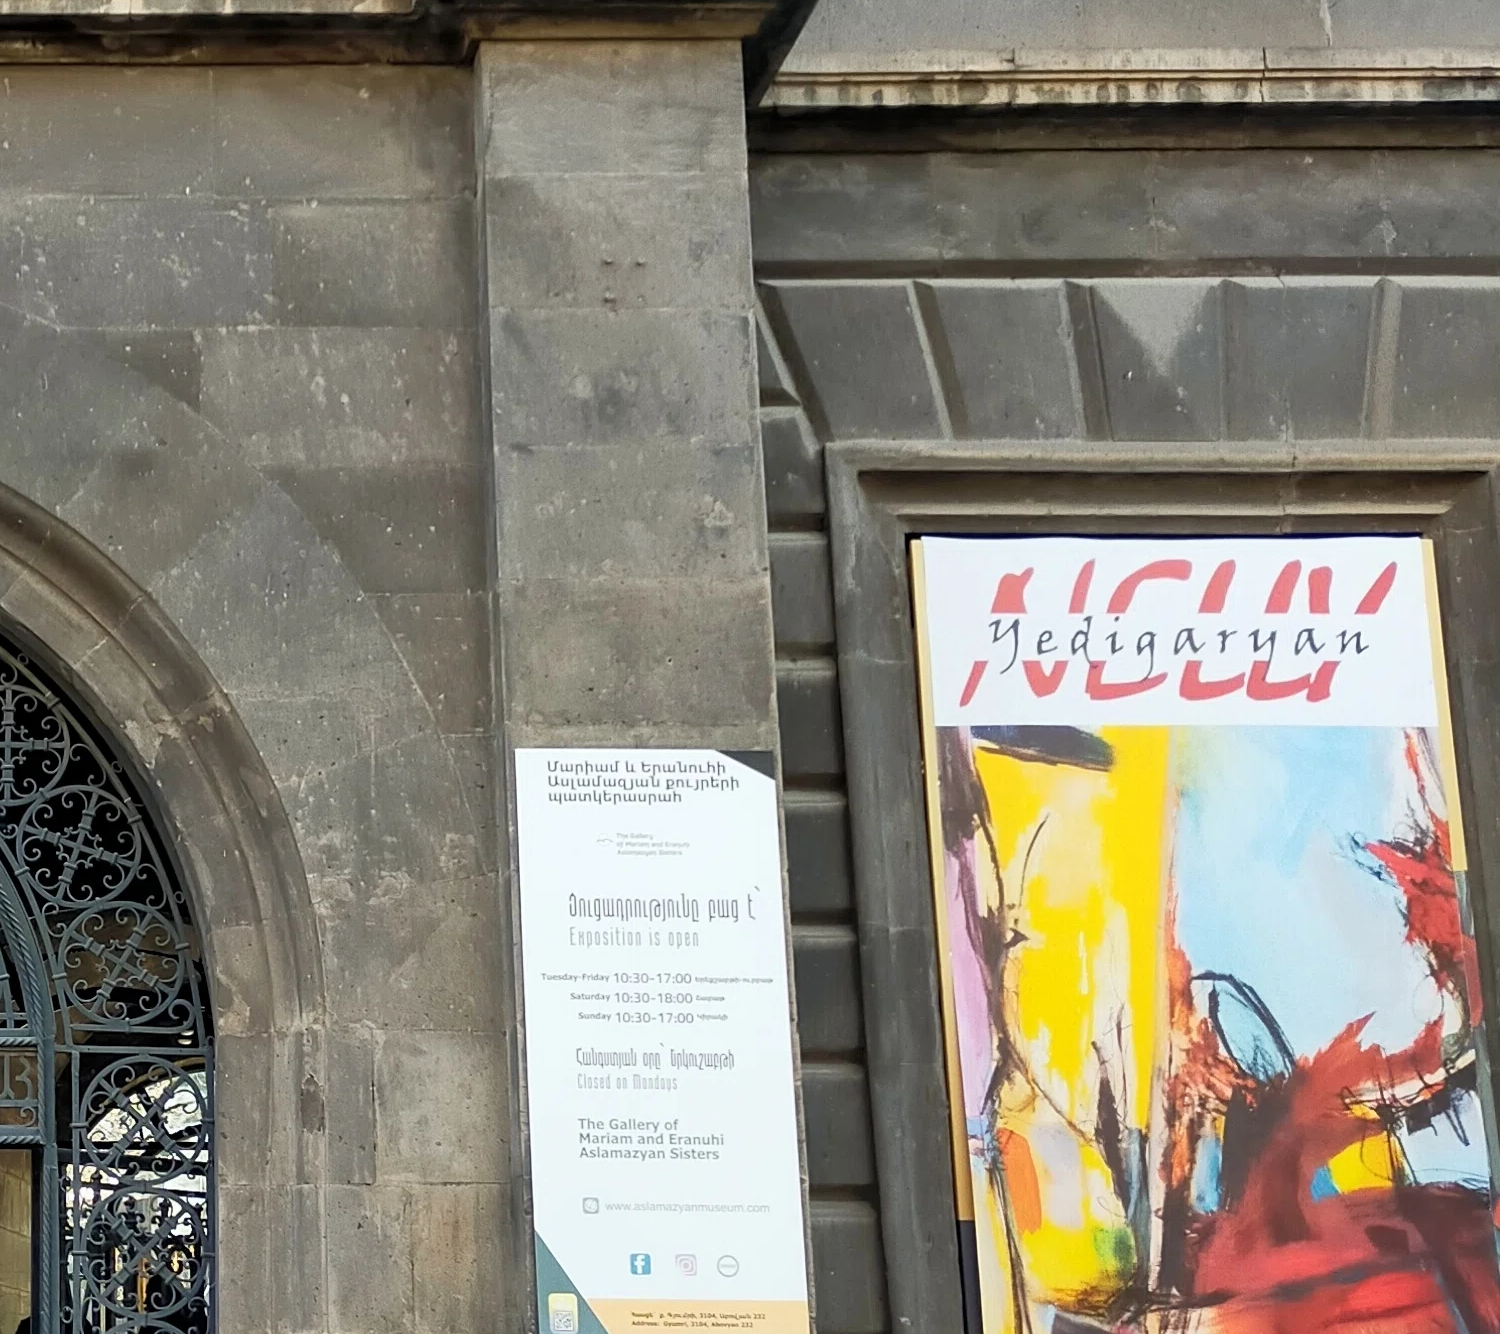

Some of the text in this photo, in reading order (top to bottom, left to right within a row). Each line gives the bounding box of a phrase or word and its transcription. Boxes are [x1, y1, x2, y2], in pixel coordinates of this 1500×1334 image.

[988, 615, 1370, 681] Yedigaryan
[547, 760, 620, 775] Մարիամ
[641, 760, 726, 776] Երանուհի
[547, 775, 740, 792] Ասլամազյան քույրերի
[548, 790, 683, 805] պատկերասրահ
[569, 926, 699, 949] Exposition is open
[613, 972, 692, 985] 10:30-17:00
[570, 992, 611, 1003] Saturday
[614, 992, 693, 1004] 10:30-18:00
[578, 1011, 612, 1022] Sunday
[615, 1012, 694, 1024] 10:30-17:00
[577, 1073, 678, 1093] Closed on Mondays
[577, 1118, 679, 1134] The Gallery of
[579, 1132, 725, 1146] Mariam and Eranuhi
[579, 1147, 720, 1162] Aslamazyan Sisters
